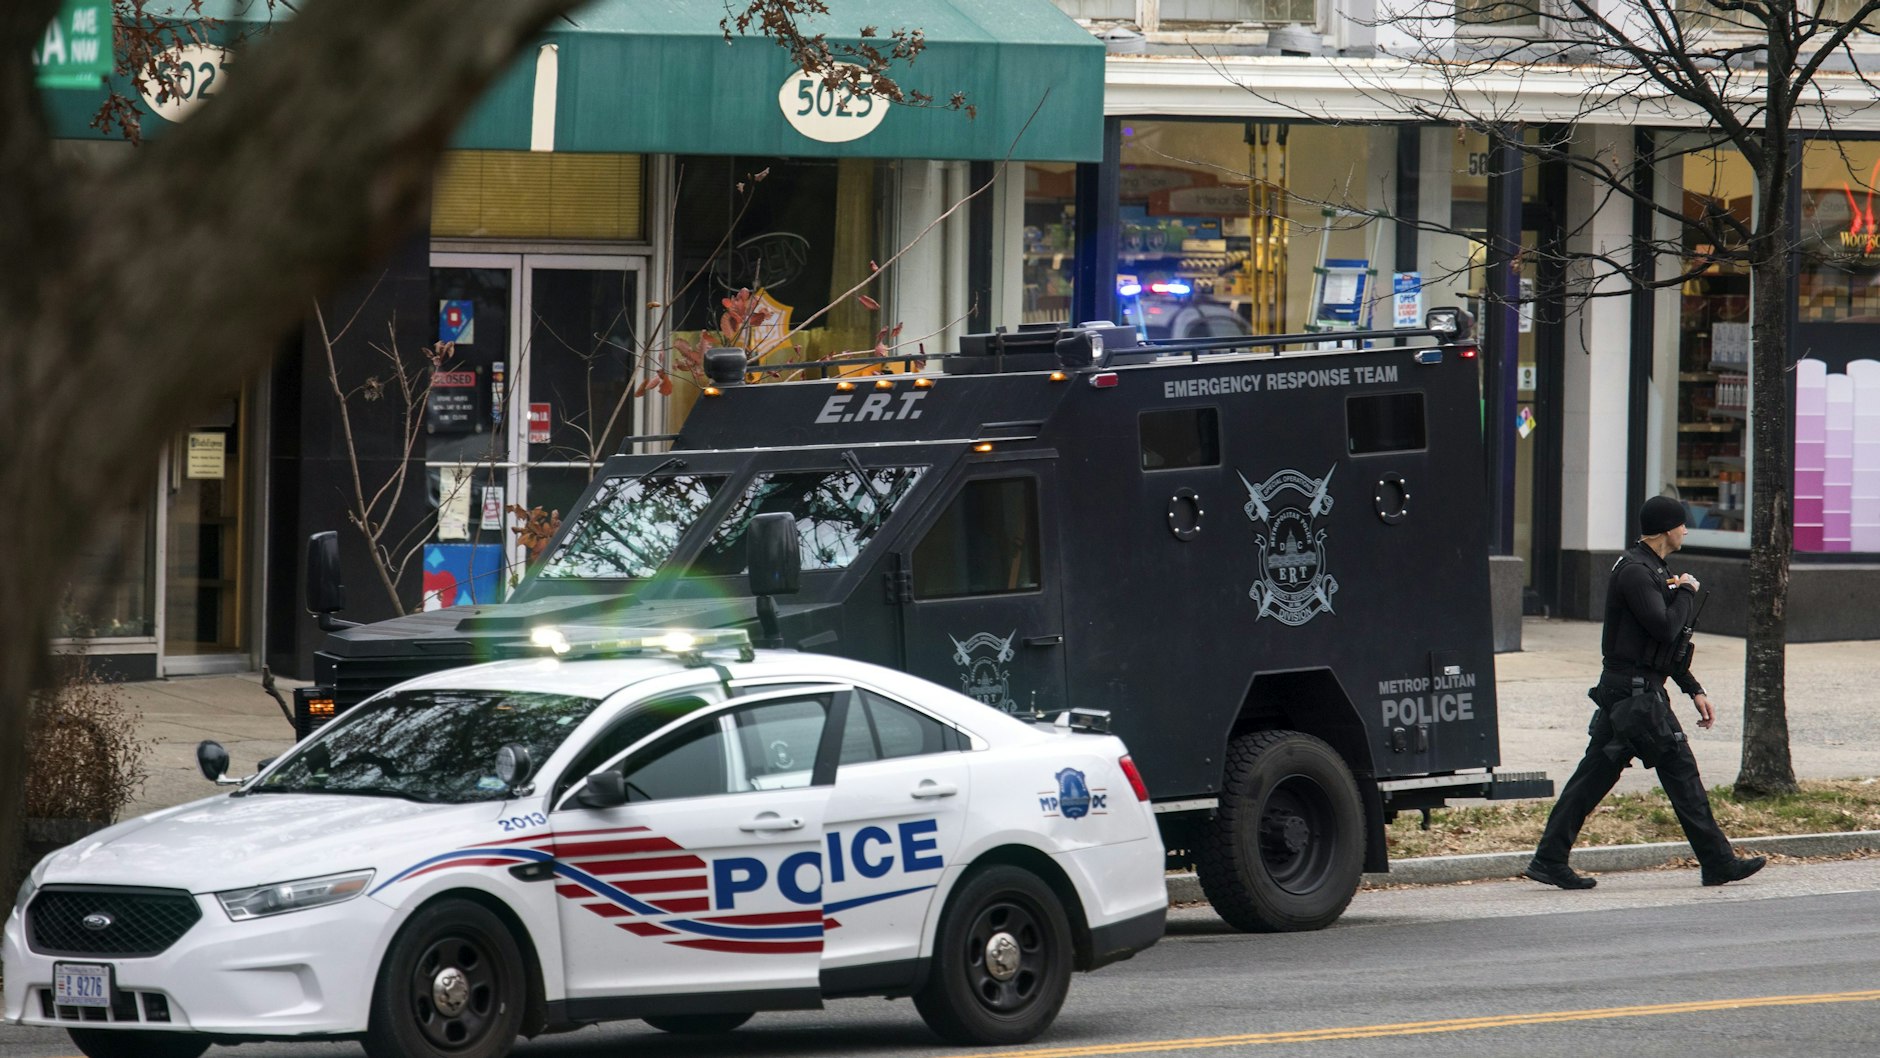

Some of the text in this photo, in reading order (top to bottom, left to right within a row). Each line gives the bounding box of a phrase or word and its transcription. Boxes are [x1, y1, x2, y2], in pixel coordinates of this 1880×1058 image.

[32, 9, 98, 66] A AVE
[70, 40, 99, 65] NW
[156, 61, 232, 108] 502
[797, 79, 873, 118] 5025
[434, 374, 472, 385] CLOSED
[1164, 365, 1398, 398] EMERGENCY RESPONSE TEAM
[814, 391, 928, 424] E.R.T.
[1270, 511, 1312, 548] METROPOLITAN POLICE
[1278, 566, 1308, 583] ERT
[1278, 606, 1313, 622] DIVISION
[1379, 673, 1475, 695] METROPOLITAN
[1381, 692, 1475, 728] POLICE
[1039, 797, 1058, 811] MP
[1092, 794, 1107, 809] DC
[498, 812, 546, 832] 2013
[713, 819, 945, 910] POICE
[77, 976, 102, 997] 9276
